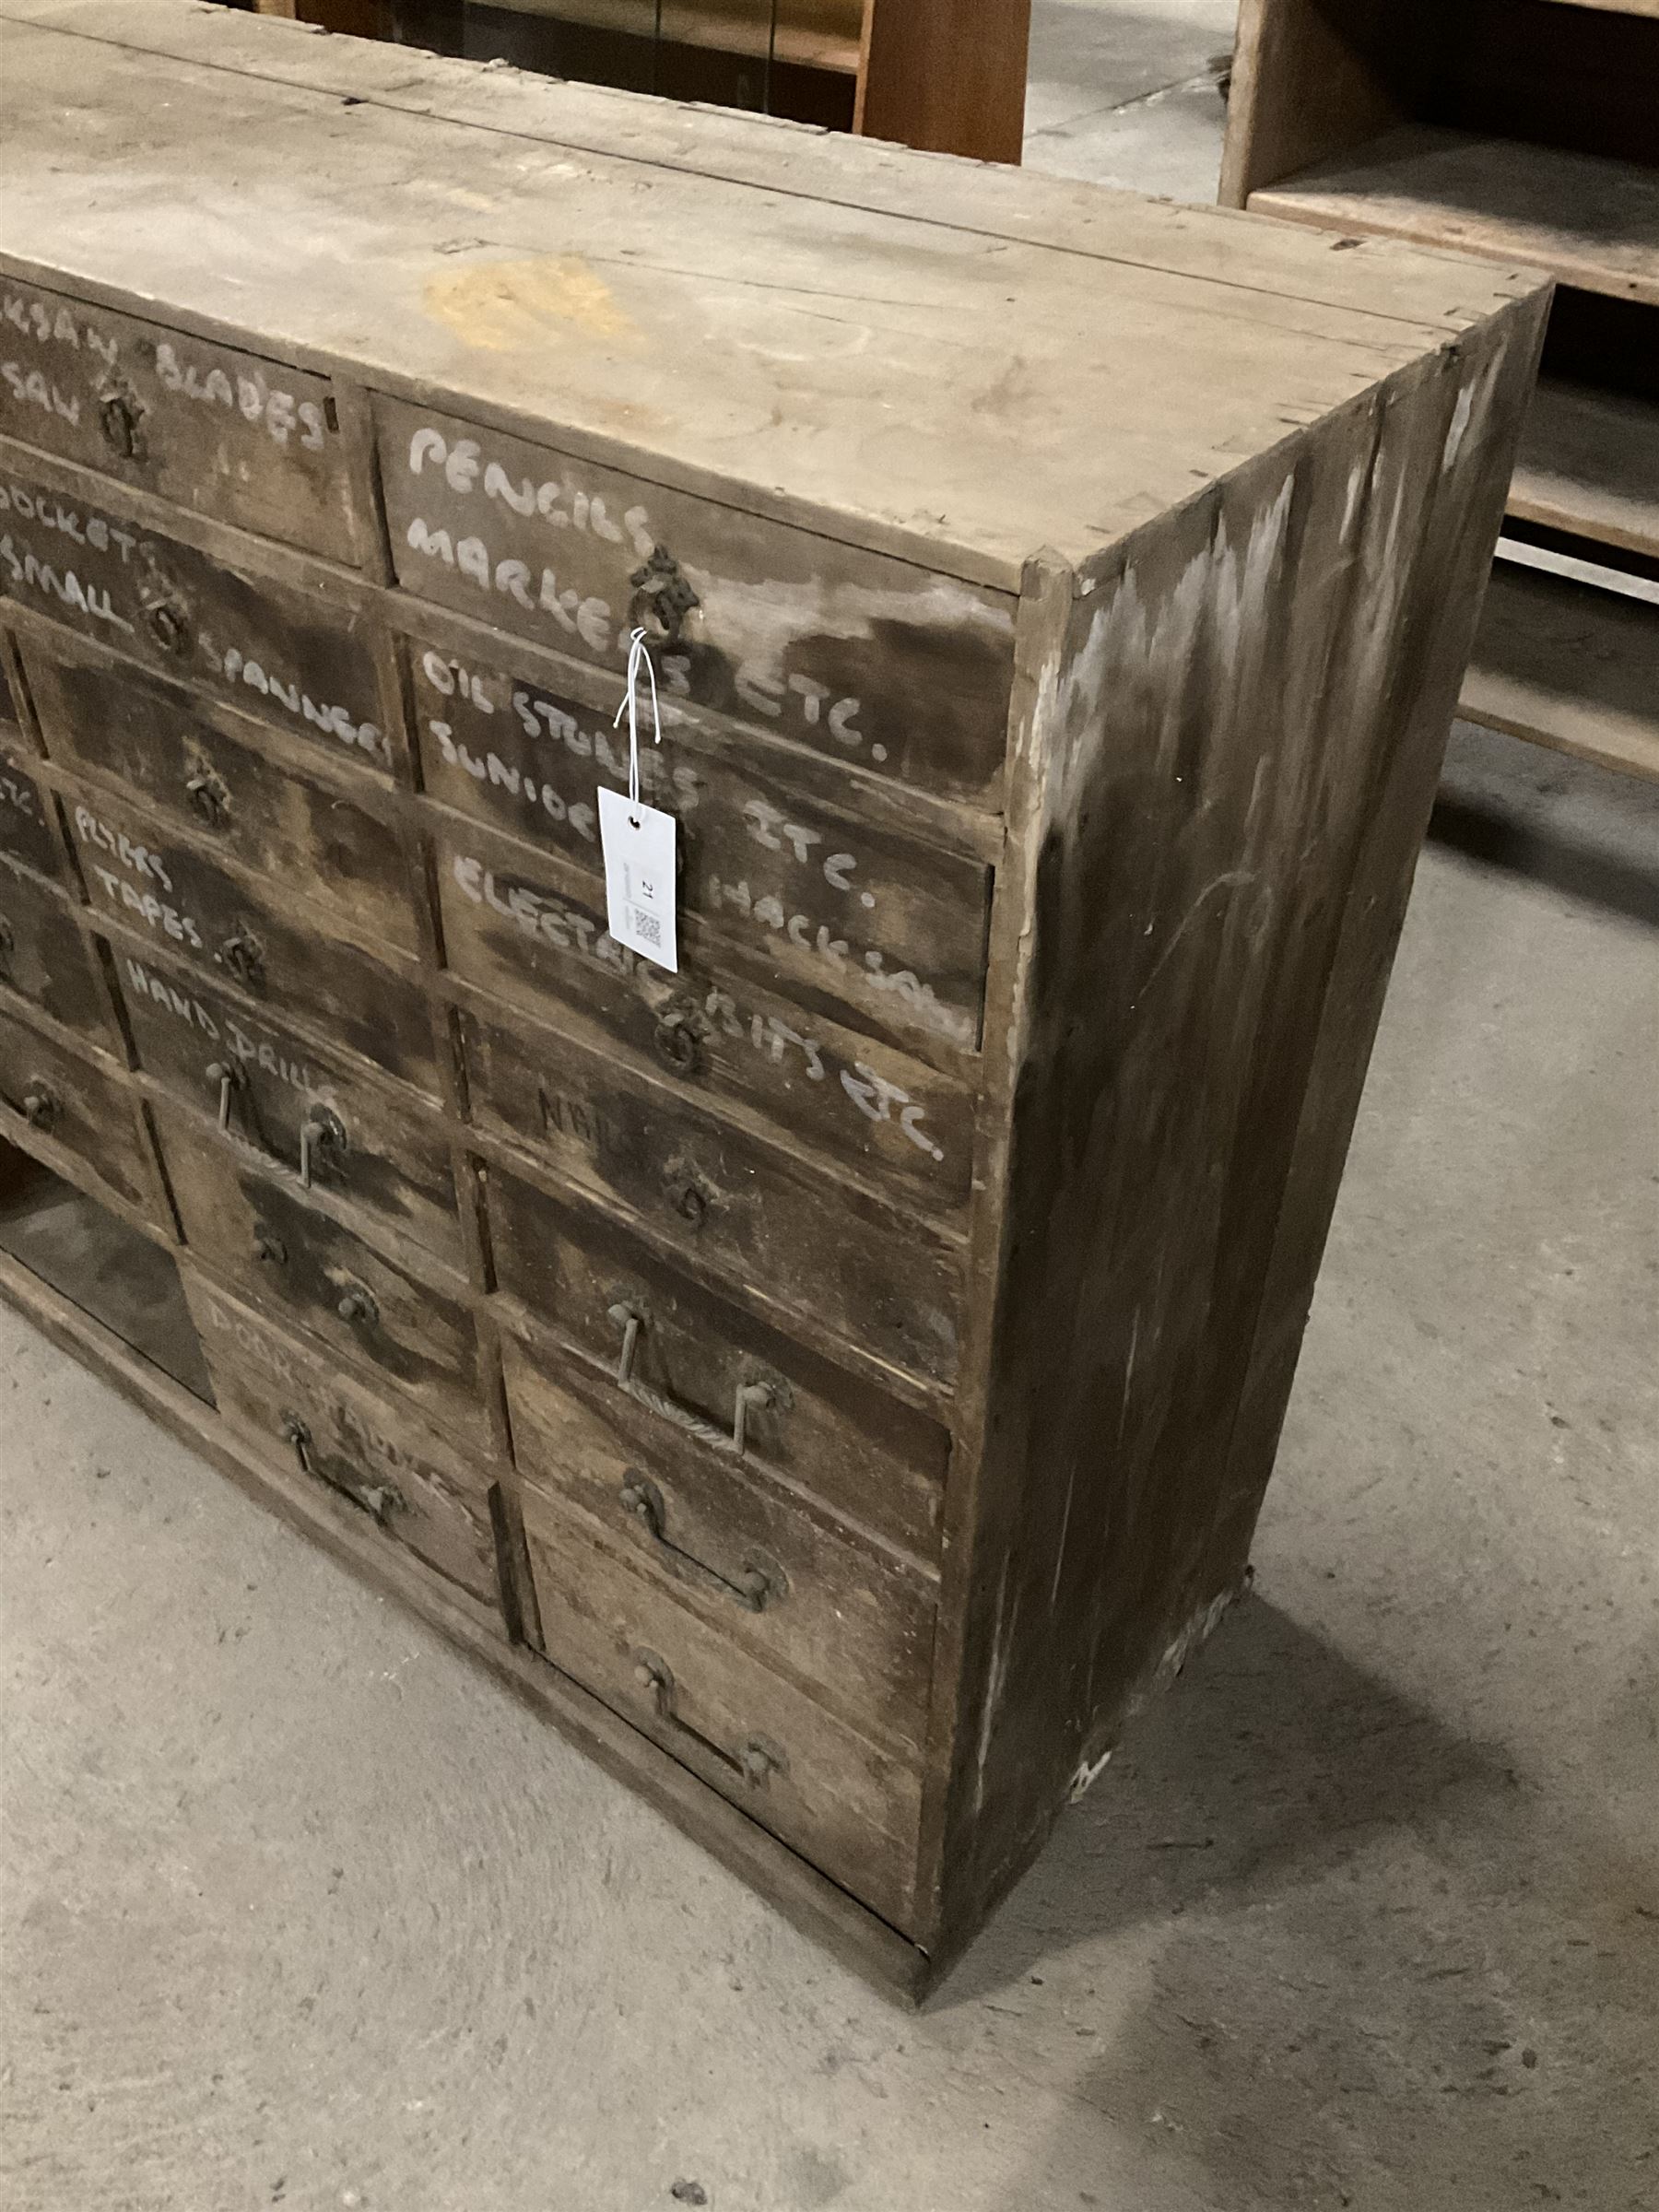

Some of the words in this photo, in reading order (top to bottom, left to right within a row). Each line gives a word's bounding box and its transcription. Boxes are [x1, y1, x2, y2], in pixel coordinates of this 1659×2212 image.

[0, 293, 119, 367] KSAW
[156, 343, 325, 451] BLADES
[0, 361, 80, 427] SAW
[409, 428, 655, 557] PENCILS
[407, 518, 691, 694] MARKES
[423, 651, 495, 714] OIL
[429, 720, 597, 843] JUNIOR
[641, 879, 653, 900] 21
